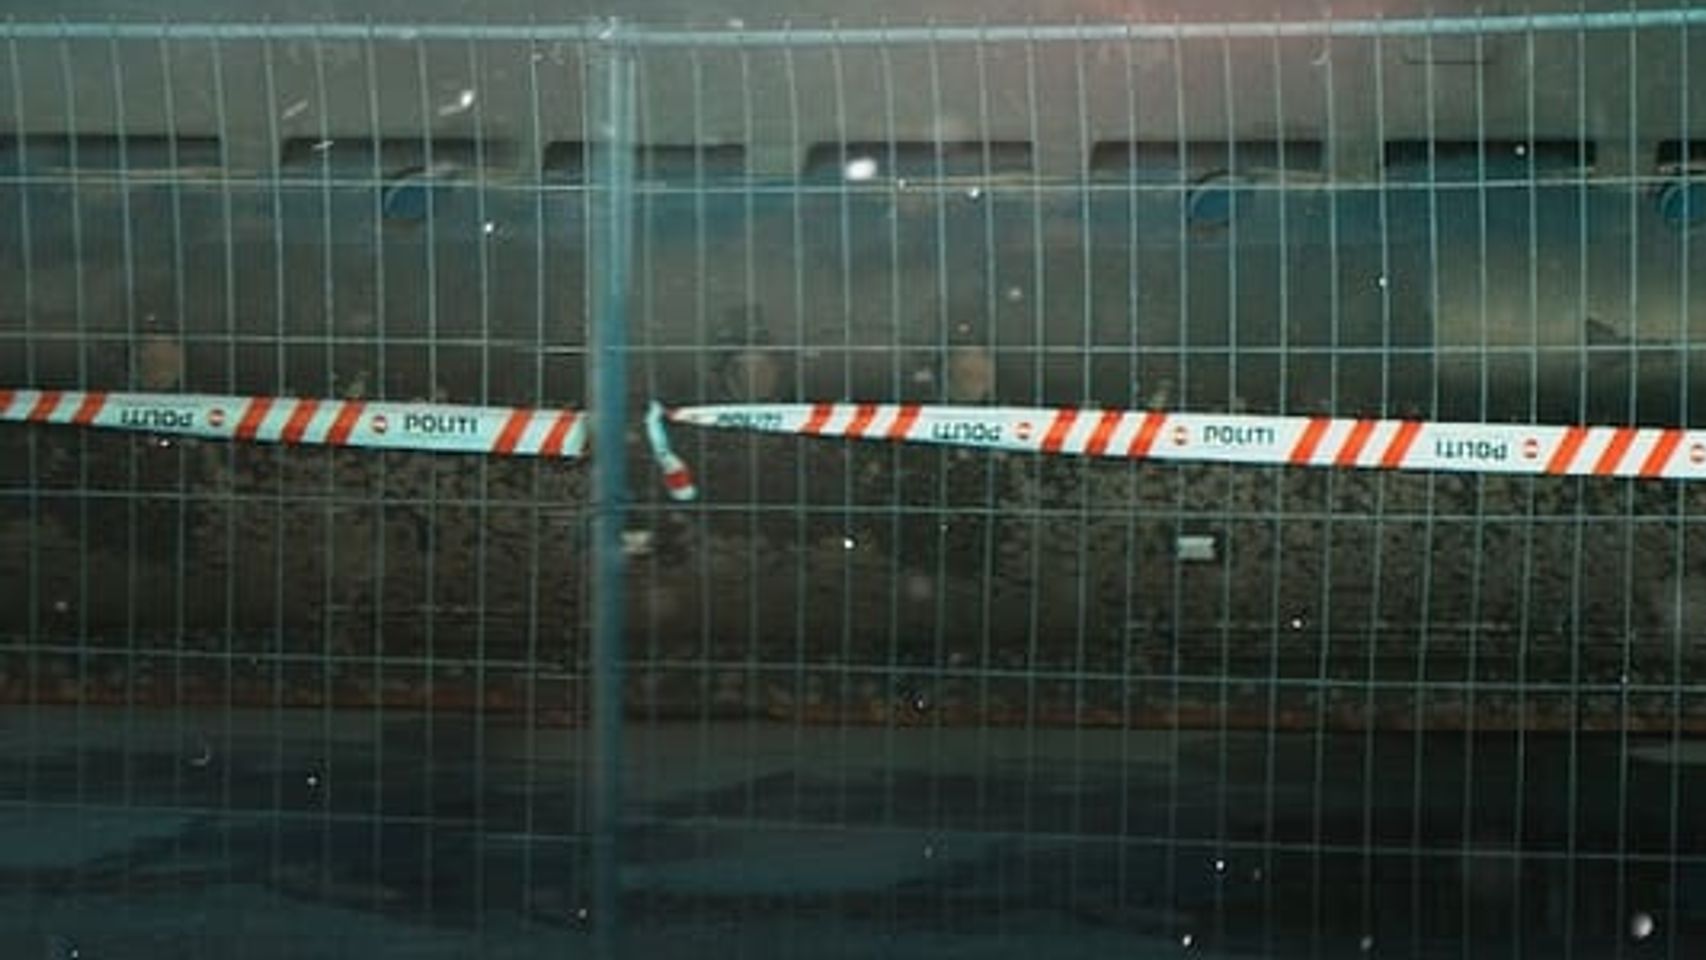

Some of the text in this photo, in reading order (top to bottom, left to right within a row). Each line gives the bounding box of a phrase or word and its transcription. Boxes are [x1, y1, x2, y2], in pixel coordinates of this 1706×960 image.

[120, 408, 194, 428] POLITI
[405, 414, 477, 434] POLITI
[1203, 425, 1275, 444] POLITI
[1436, 439, 1509, 459] POLITI
